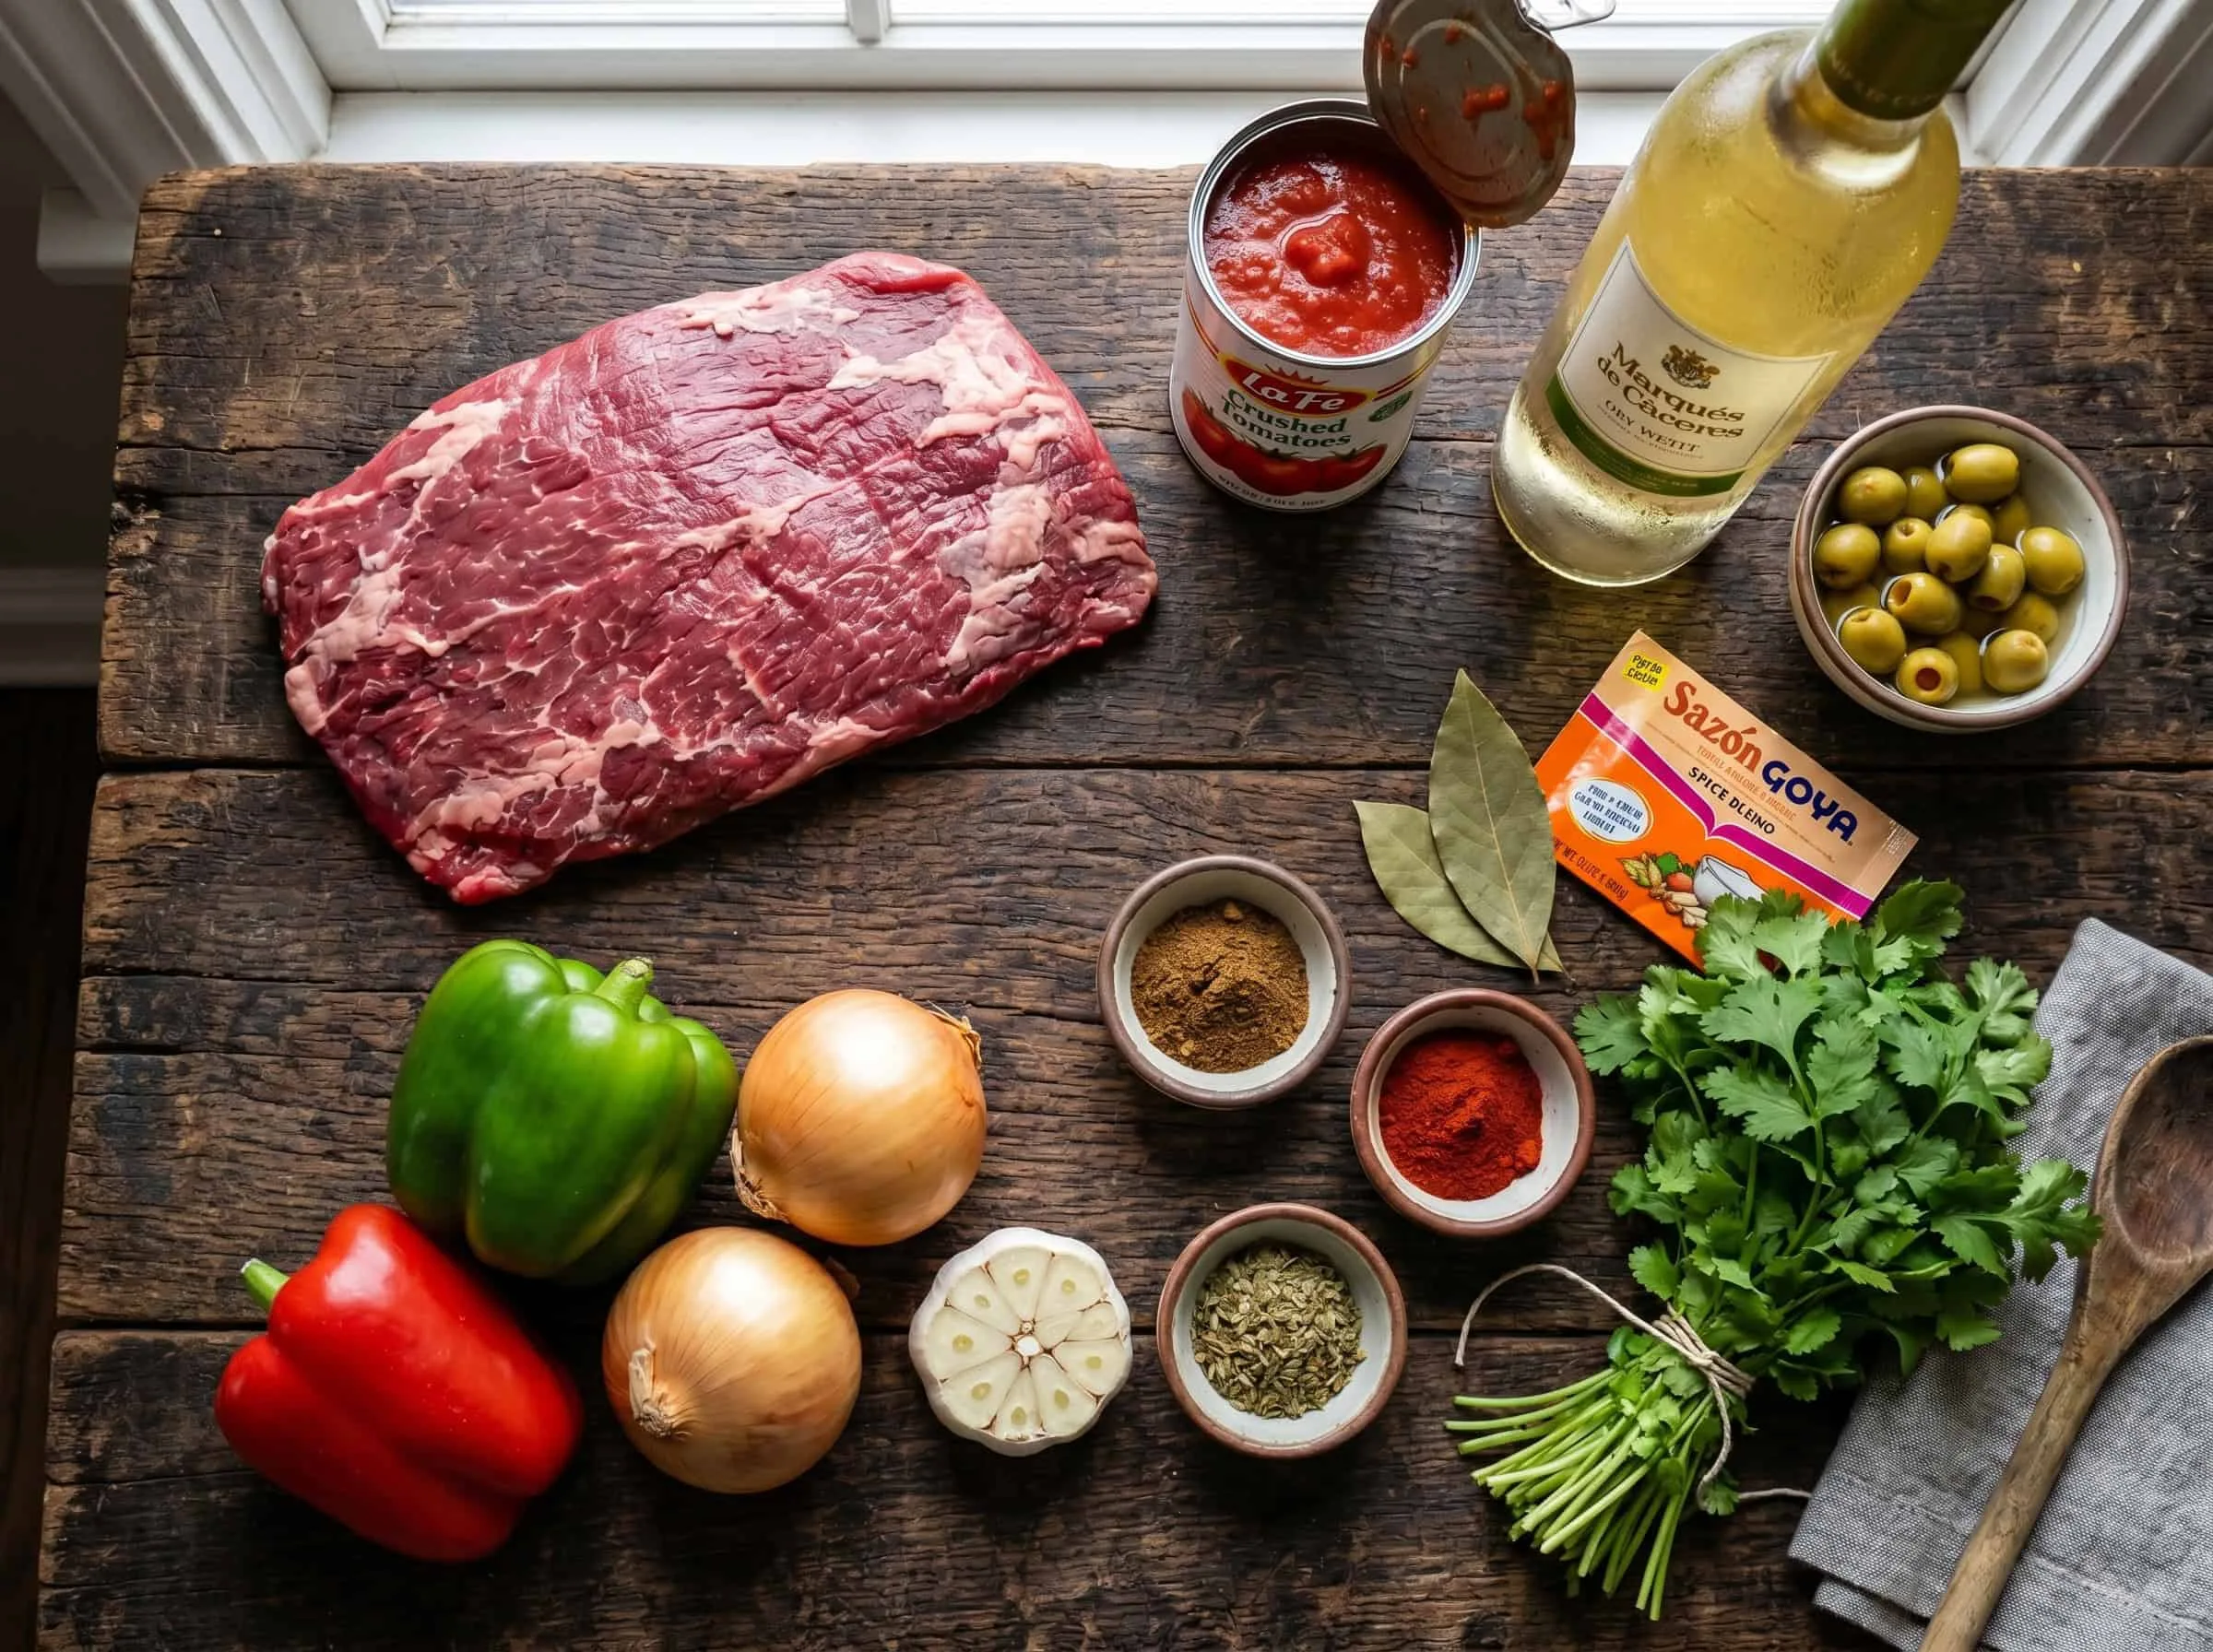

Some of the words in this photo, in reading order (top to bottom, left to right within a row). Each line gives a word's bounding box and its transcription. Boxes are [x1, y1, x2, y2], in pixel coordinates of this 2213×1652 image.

[1242, 372, 1290, 404] La
[1294, 390, 1346, 411] Fe
[1597, 356, 1621, 387] de
[1612, 340, 1746, 422] Marqués
[1221, 395, 1353, 448] Tomatoes
[1227, 388, 1348, 434] Crushed
[1663, 680, 1763, 773] Sazón
[1761, 760, 1859, 843] GOYA
[1688, 766, 1730, 802] SPICE
